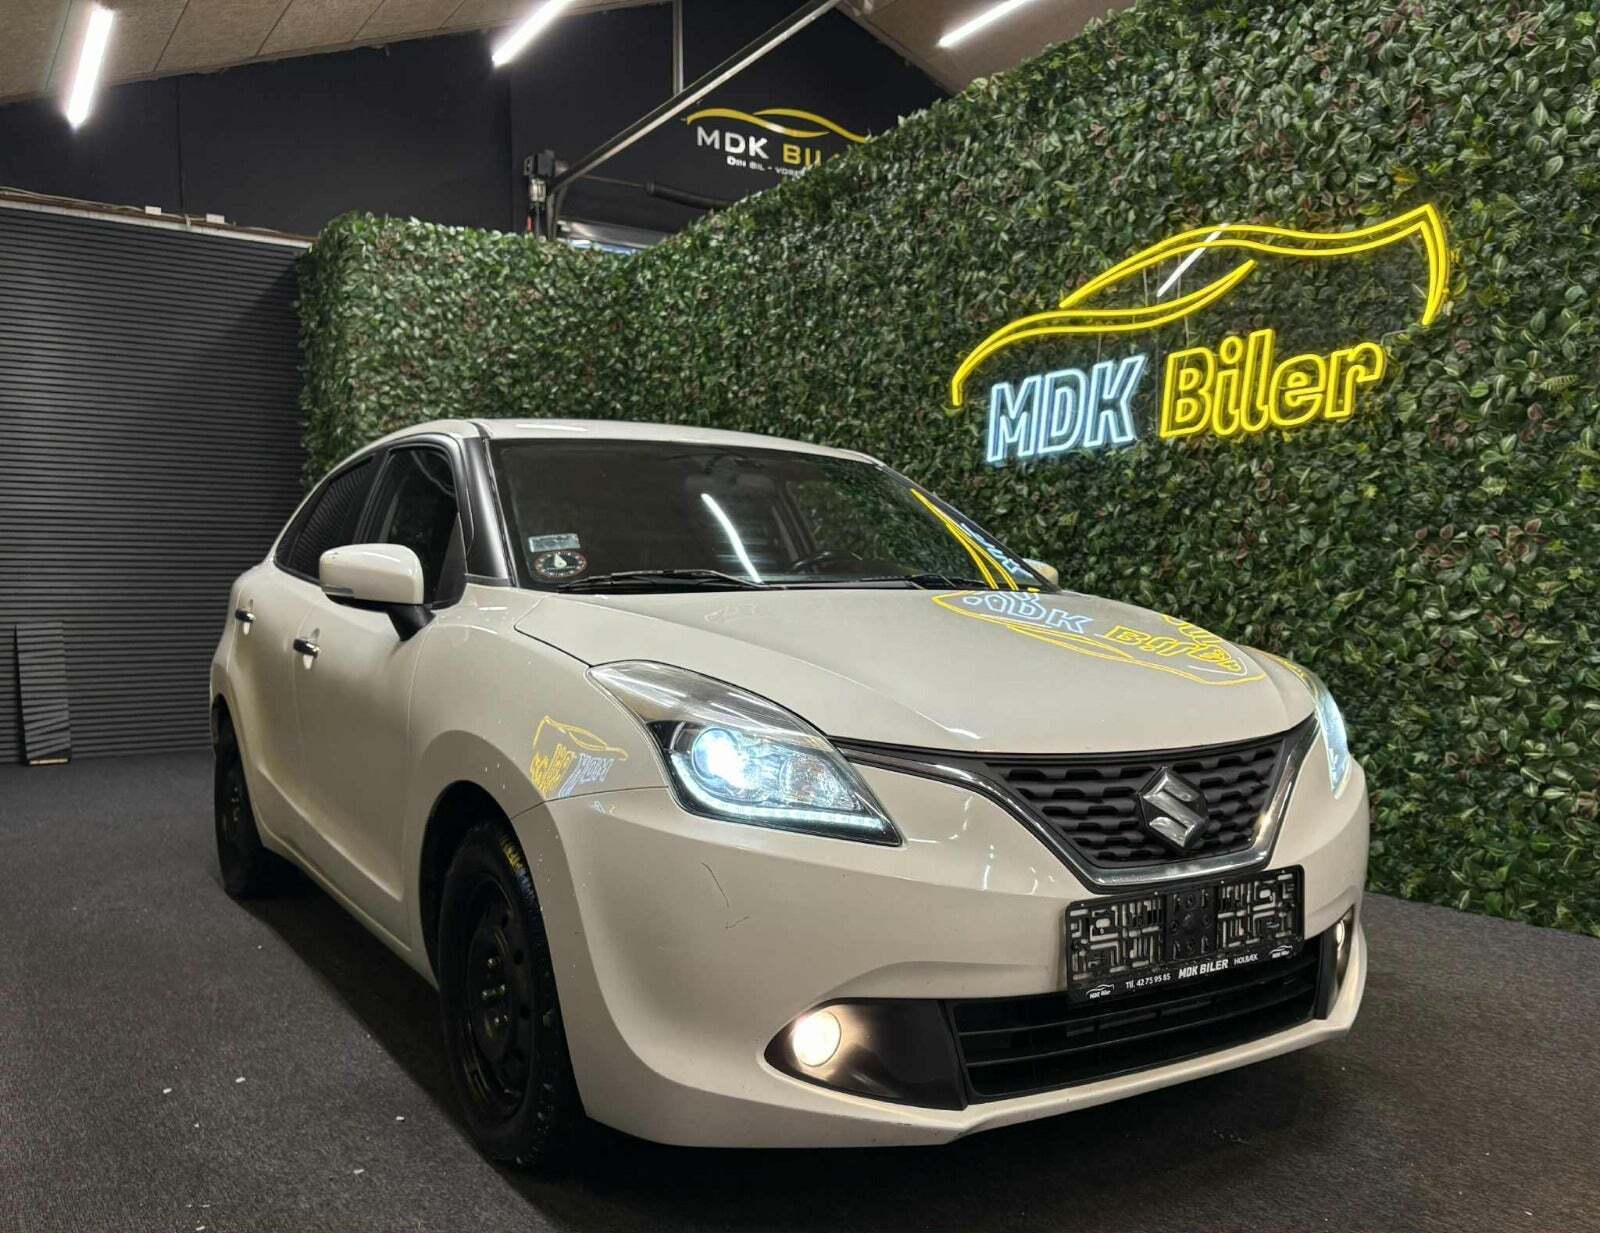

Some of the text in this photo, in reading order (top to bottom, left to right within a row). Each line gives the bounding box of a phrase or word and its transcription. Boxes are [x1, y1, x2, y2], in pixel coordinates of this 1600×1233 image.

[696, 126, 769, 160] MDK
[986, 328, 1386, 463] MDK Biler
[1136, 978, 1145, 986] 42
[1178, 965, 1199, 979] MDK
[1199, 959, 1229, 974] BILER
